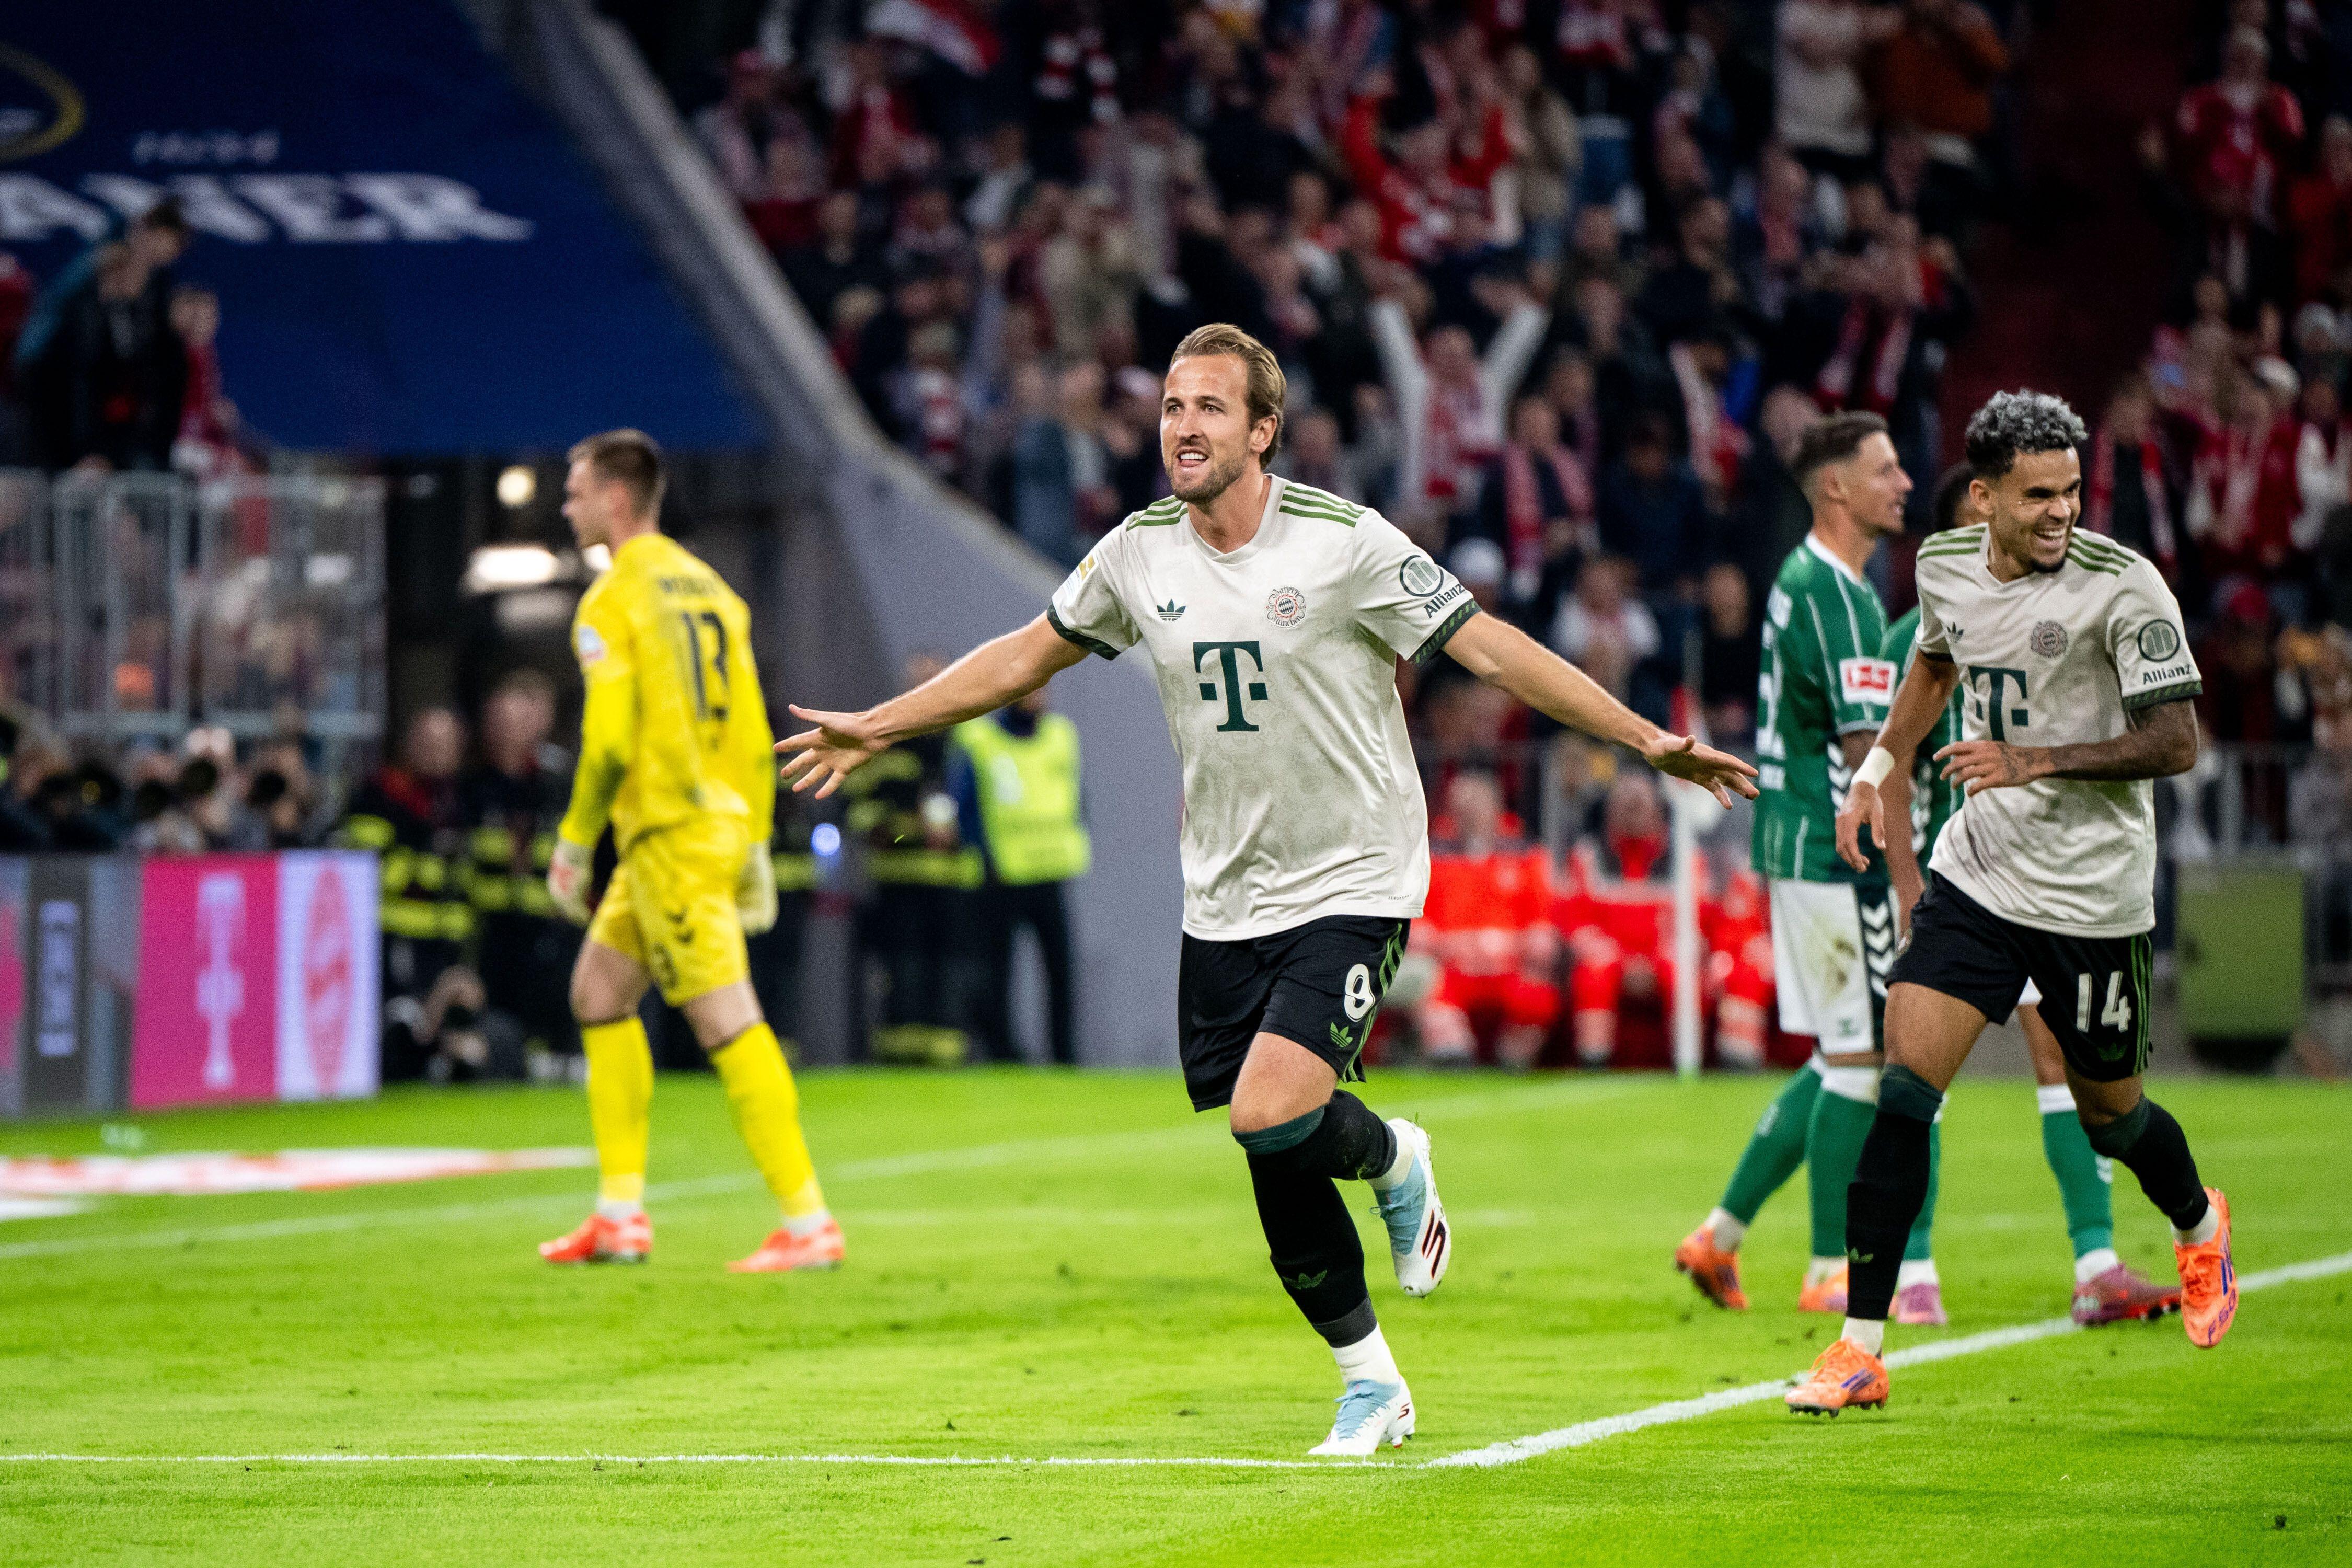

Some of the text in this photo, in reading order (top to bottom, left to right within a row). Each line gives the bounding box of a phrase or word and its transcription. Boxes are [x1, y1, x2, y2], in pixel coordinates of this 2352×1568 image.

[1423, 583, 1465, 618] Allianz
[1193, 641, 1268, 732] T
[1967, 665, 2029, 741] T
[2076, 970, 2131, 1032] 14
